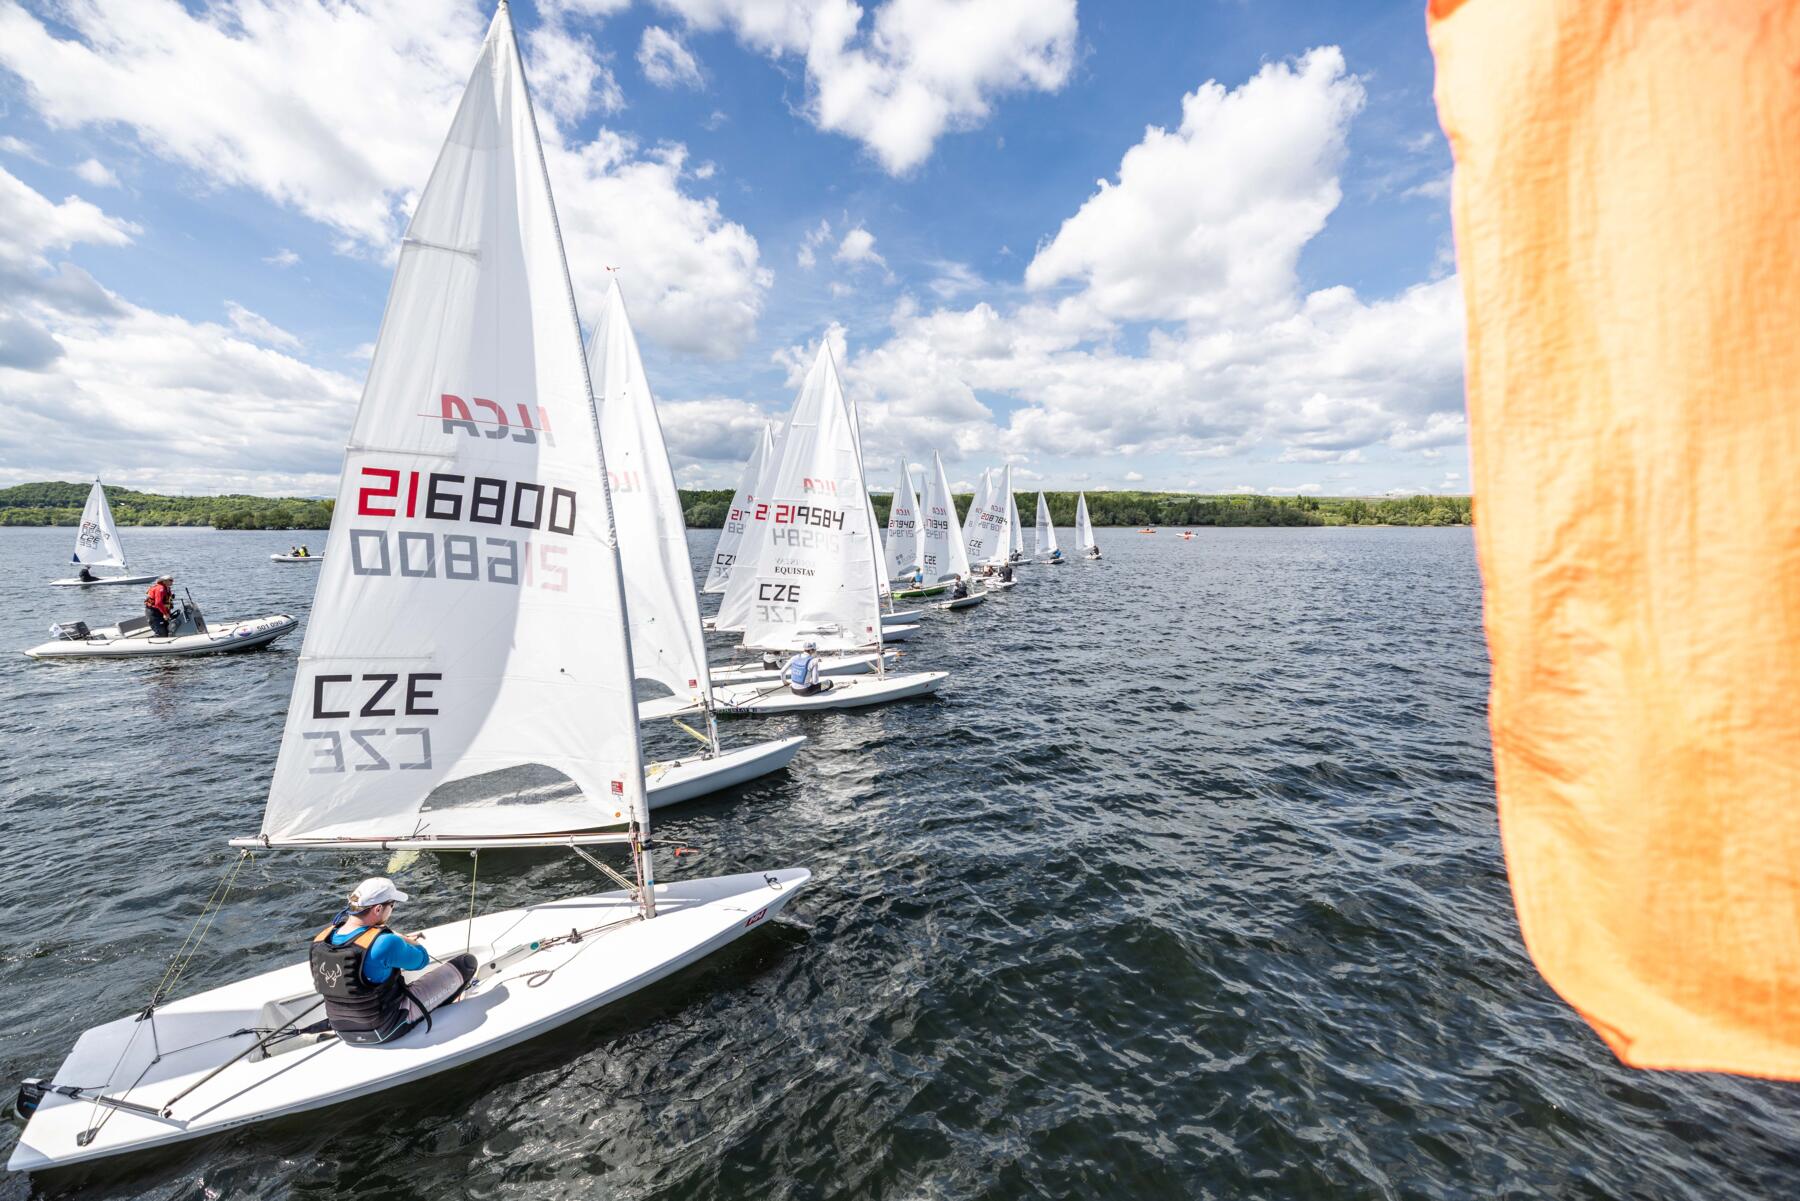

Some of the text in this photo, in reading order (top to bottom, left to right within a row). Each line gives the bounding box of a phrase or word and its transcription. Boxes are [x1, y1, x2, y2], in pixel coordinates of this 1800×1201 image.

[357, 467, 577, 536] 216800
[775, 505, 845, 530] 219584
[969, 539, 983, 549] CZE
[716, 554, 737, 565] CZ
[758, 584, 801, 602] CZE
[313, 673, 443, 719] CZE
